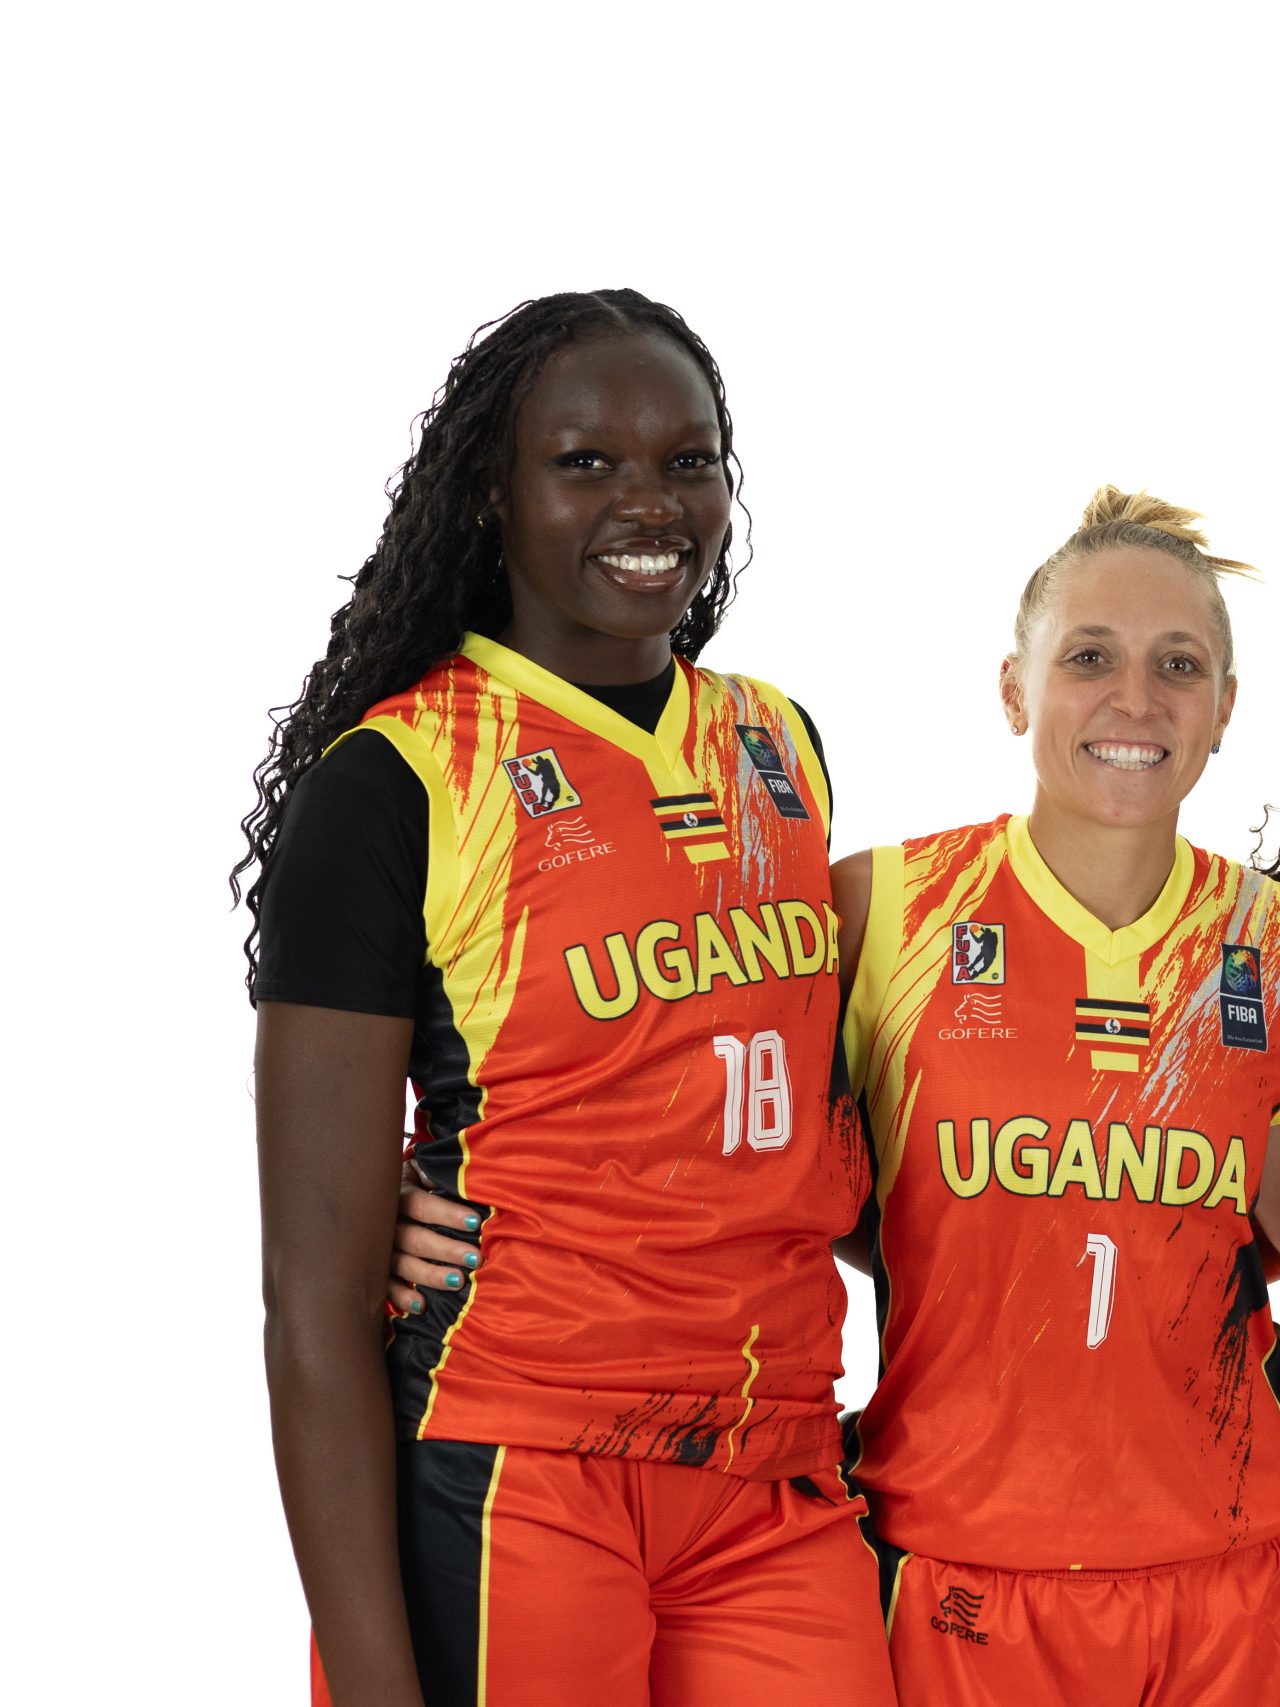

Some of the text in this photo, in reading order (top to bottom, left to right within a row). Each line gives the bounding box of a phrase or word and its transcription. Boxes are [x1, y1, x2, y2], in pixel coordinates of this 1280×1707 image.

[506, 760, 549, 816] FUBA
[767, 778, 794, 795] FIBA
[538, 841, 617, 872] GOFERE
[563, 899, 840, 1021] UGANDA
[955, 925, 972, 981] FUBA
[938, 1028, 1018, 1040] GOFERE
[1227, 1003, 1258, 1025] FIBA
[712, 1029, 794, 1157] 18
[936, 1115, 1249, 1216] UGANDA
[1085, 1233, 1119, 1349] 1
[930, 1615, 989, 1646] GOFERE
